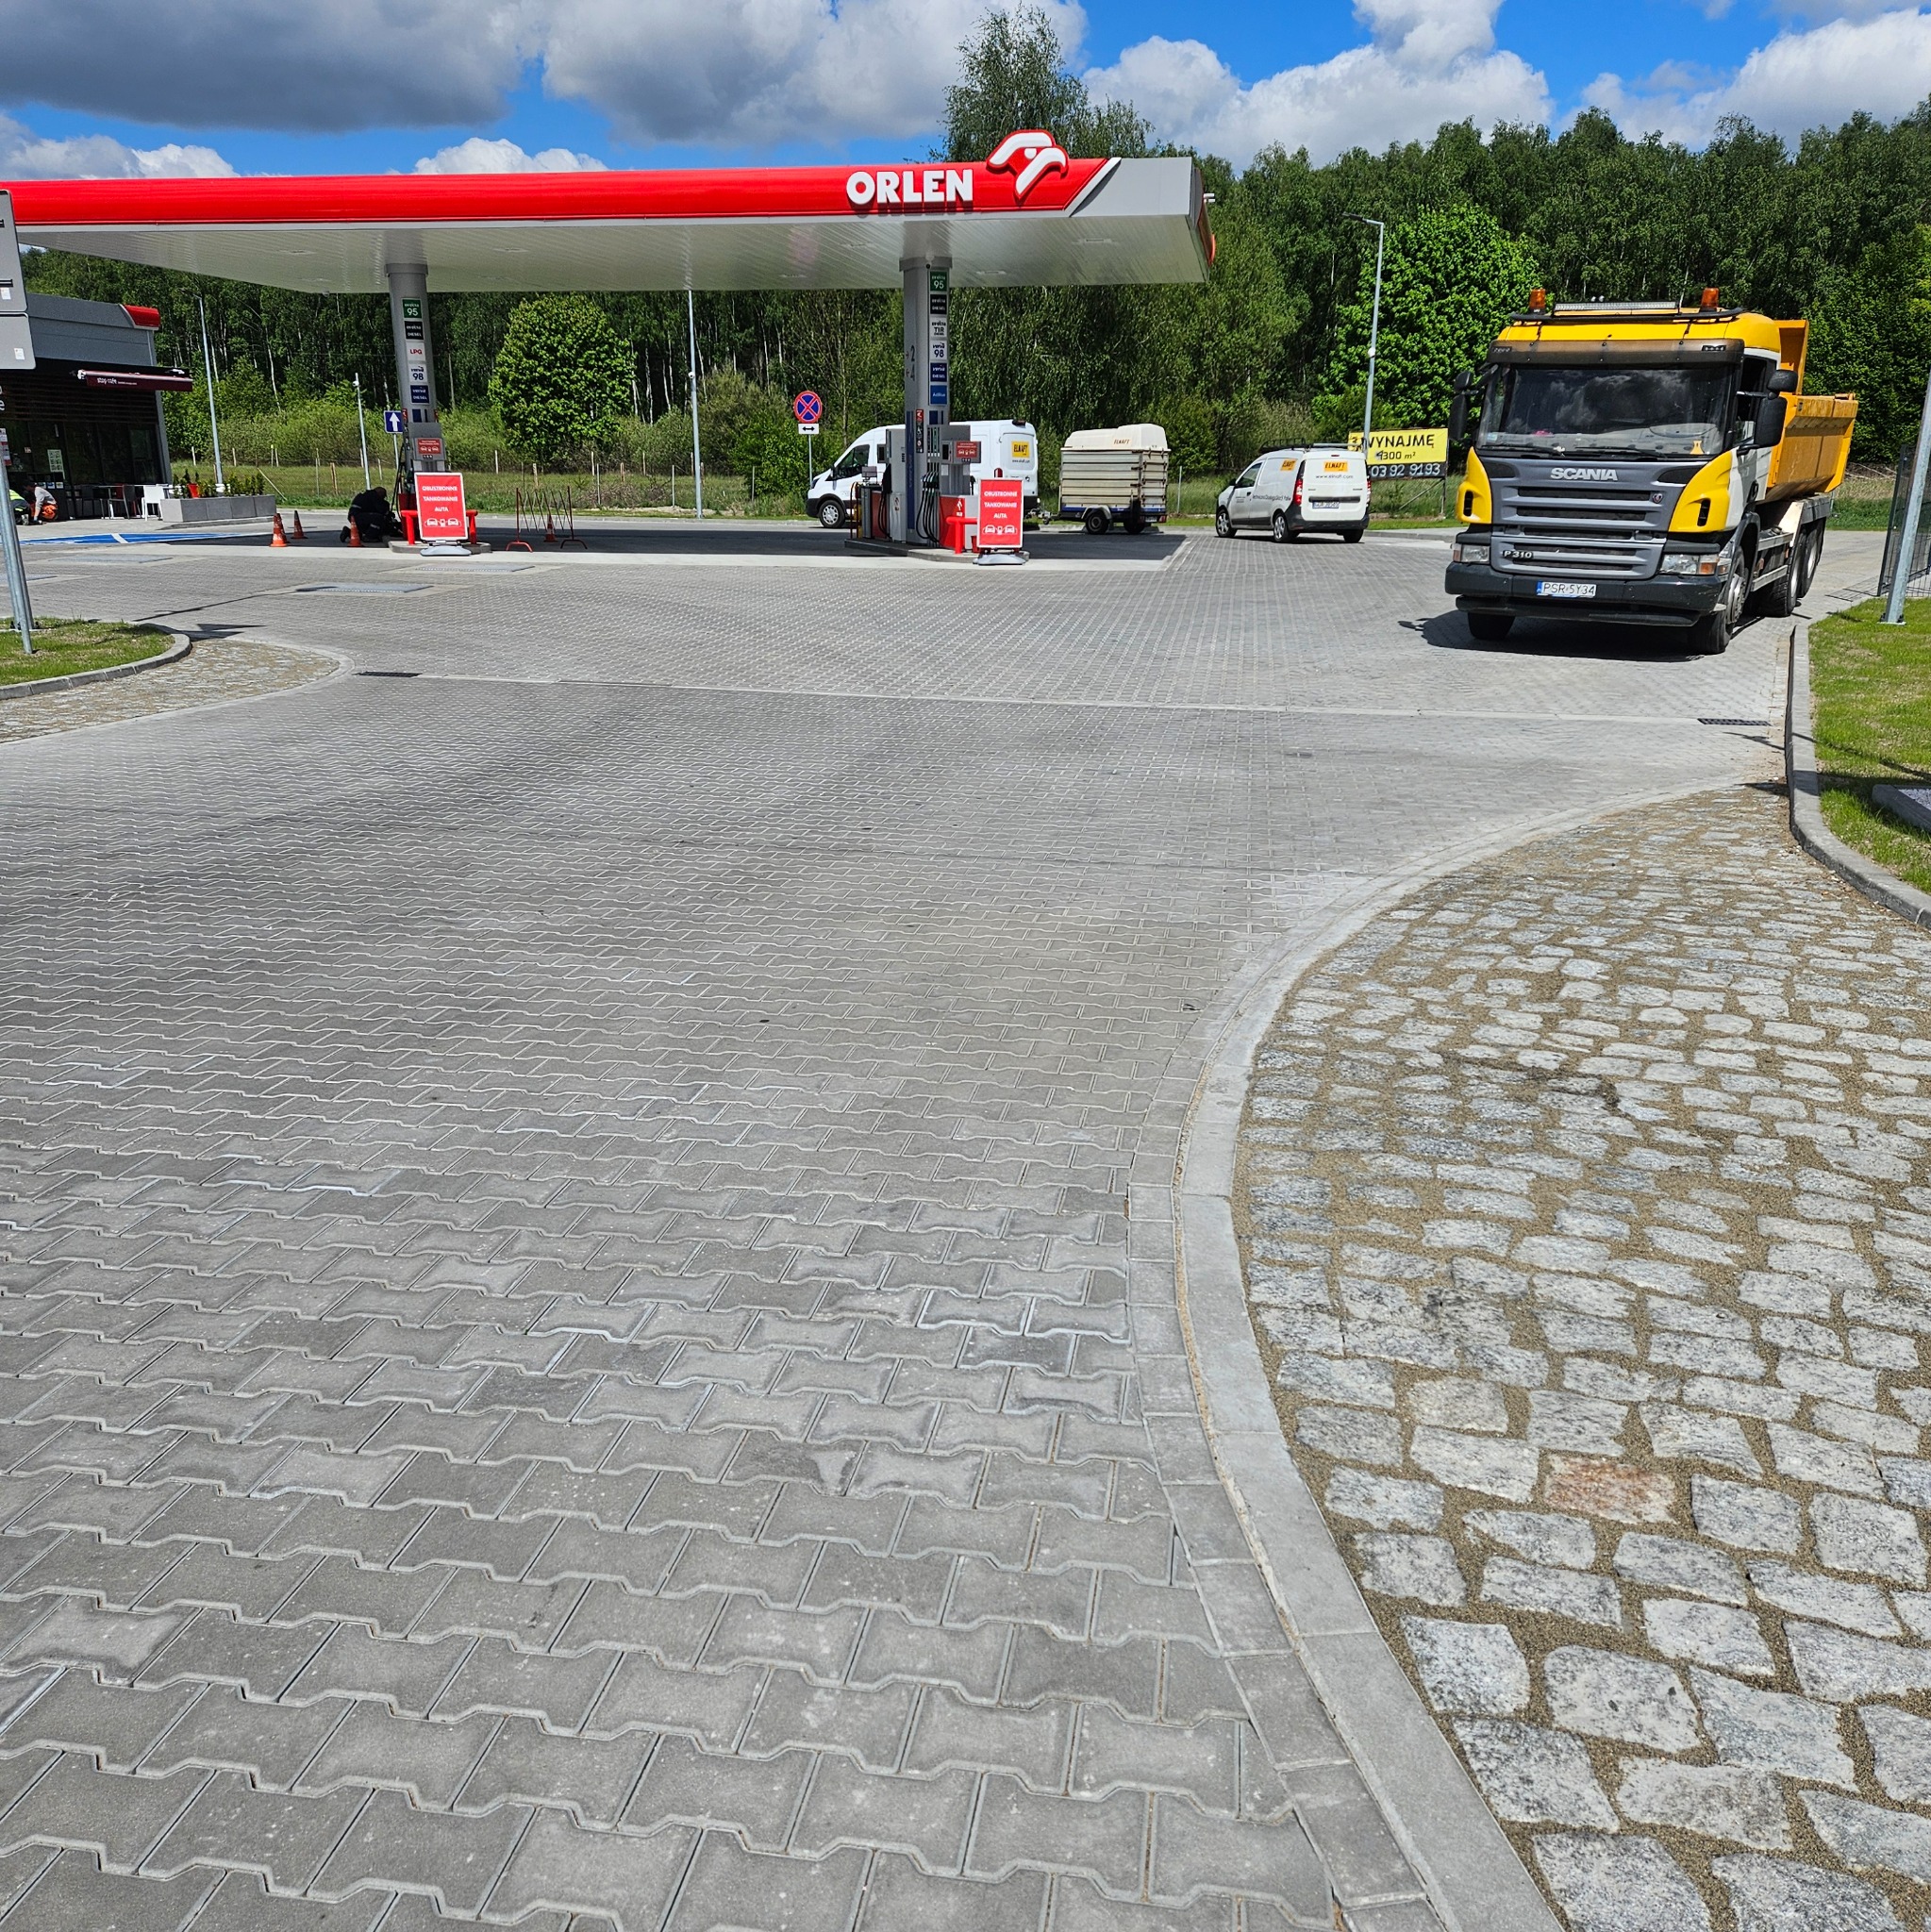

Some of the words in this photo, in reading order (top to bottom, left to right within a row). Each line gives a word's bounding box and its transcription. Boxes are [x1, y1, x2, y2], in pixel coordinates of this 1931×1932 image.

[846, 168, 974, 206] ORLEN
[934, 280, 944, 290] 95
[407, 308, 419, 317] 95
[934, 349, 944, 358] 98
[412, 373, 424, 381] 98
[1390, 464, 1406, 476] 92
[1550, 467, 1619, 481] SCANIA
